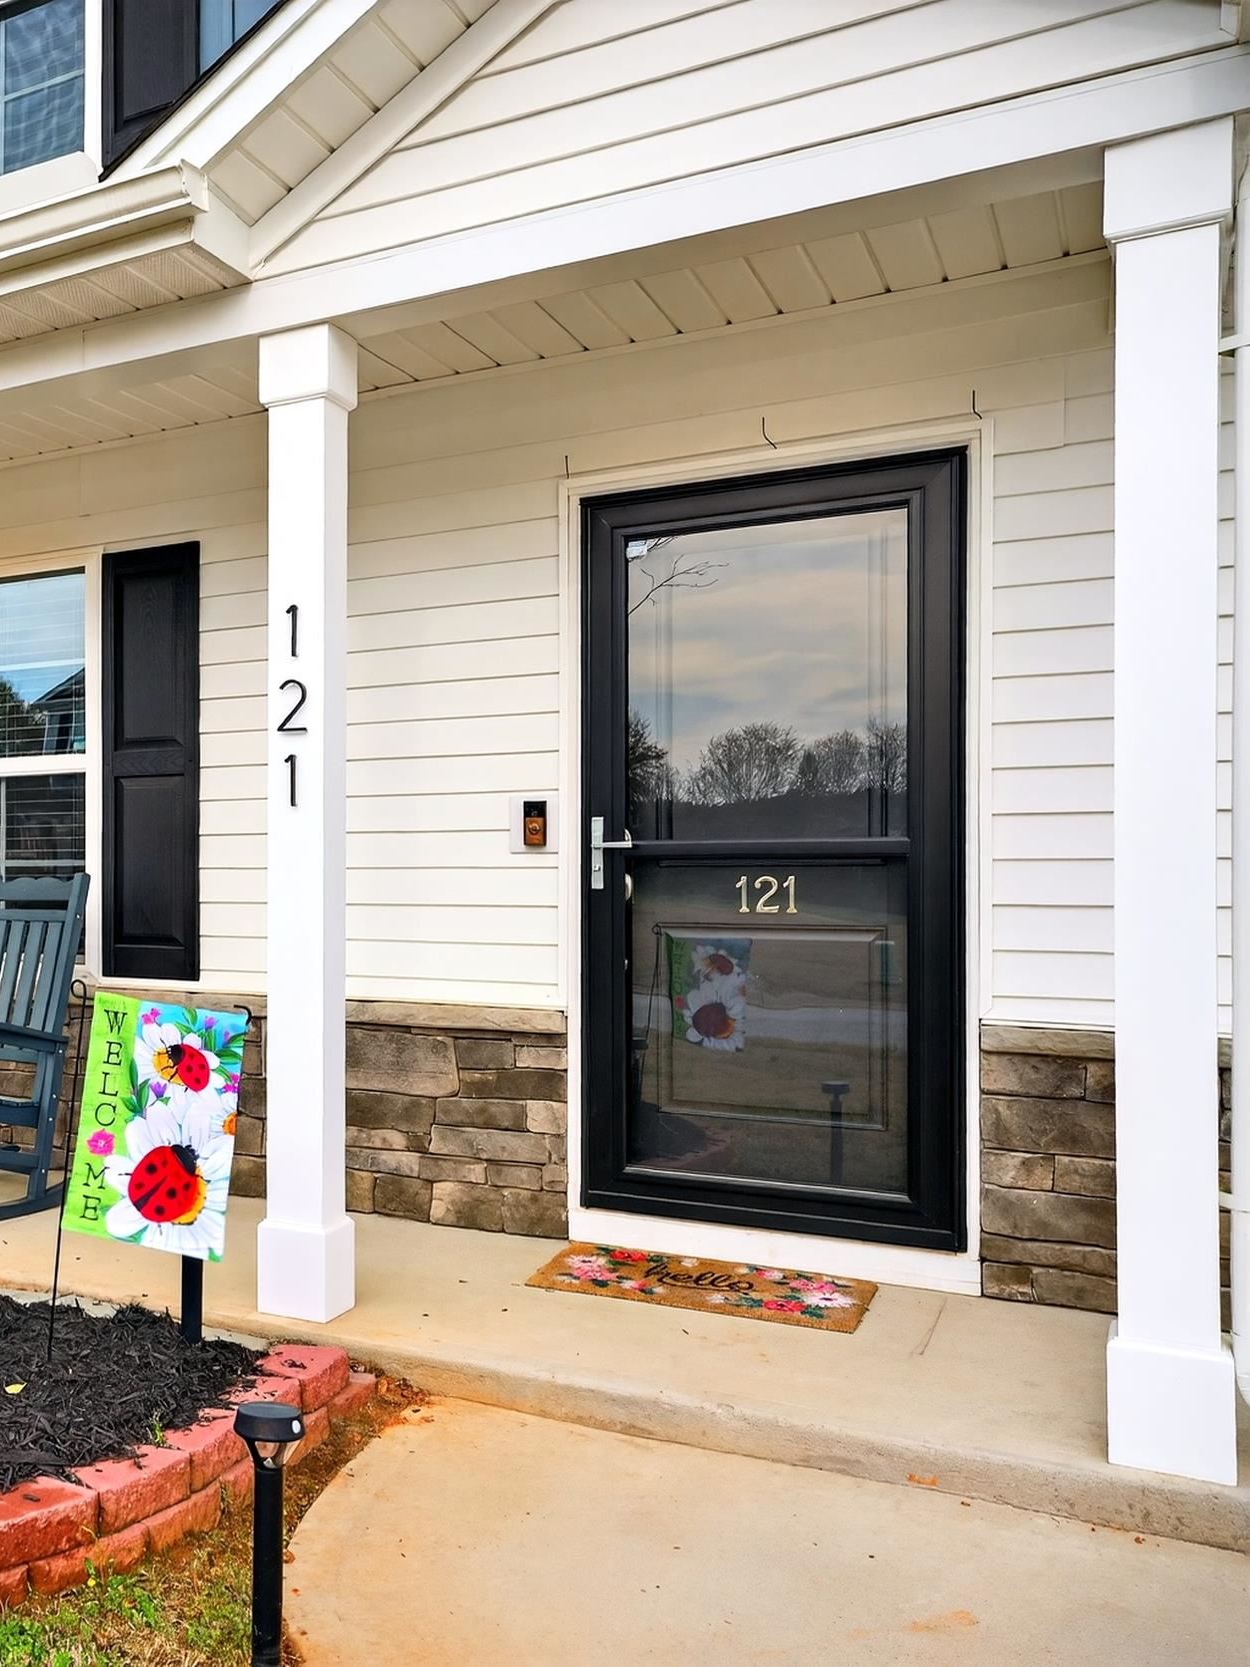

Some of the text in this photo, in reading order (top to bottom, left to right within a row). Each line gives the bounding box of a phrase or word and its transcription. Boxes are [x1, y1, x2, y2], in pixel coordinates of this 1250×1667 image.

[276, 603, 308, 808] 121
[735, 875, 798, 913] 121
[644, 1262, 754, 1293] hello
